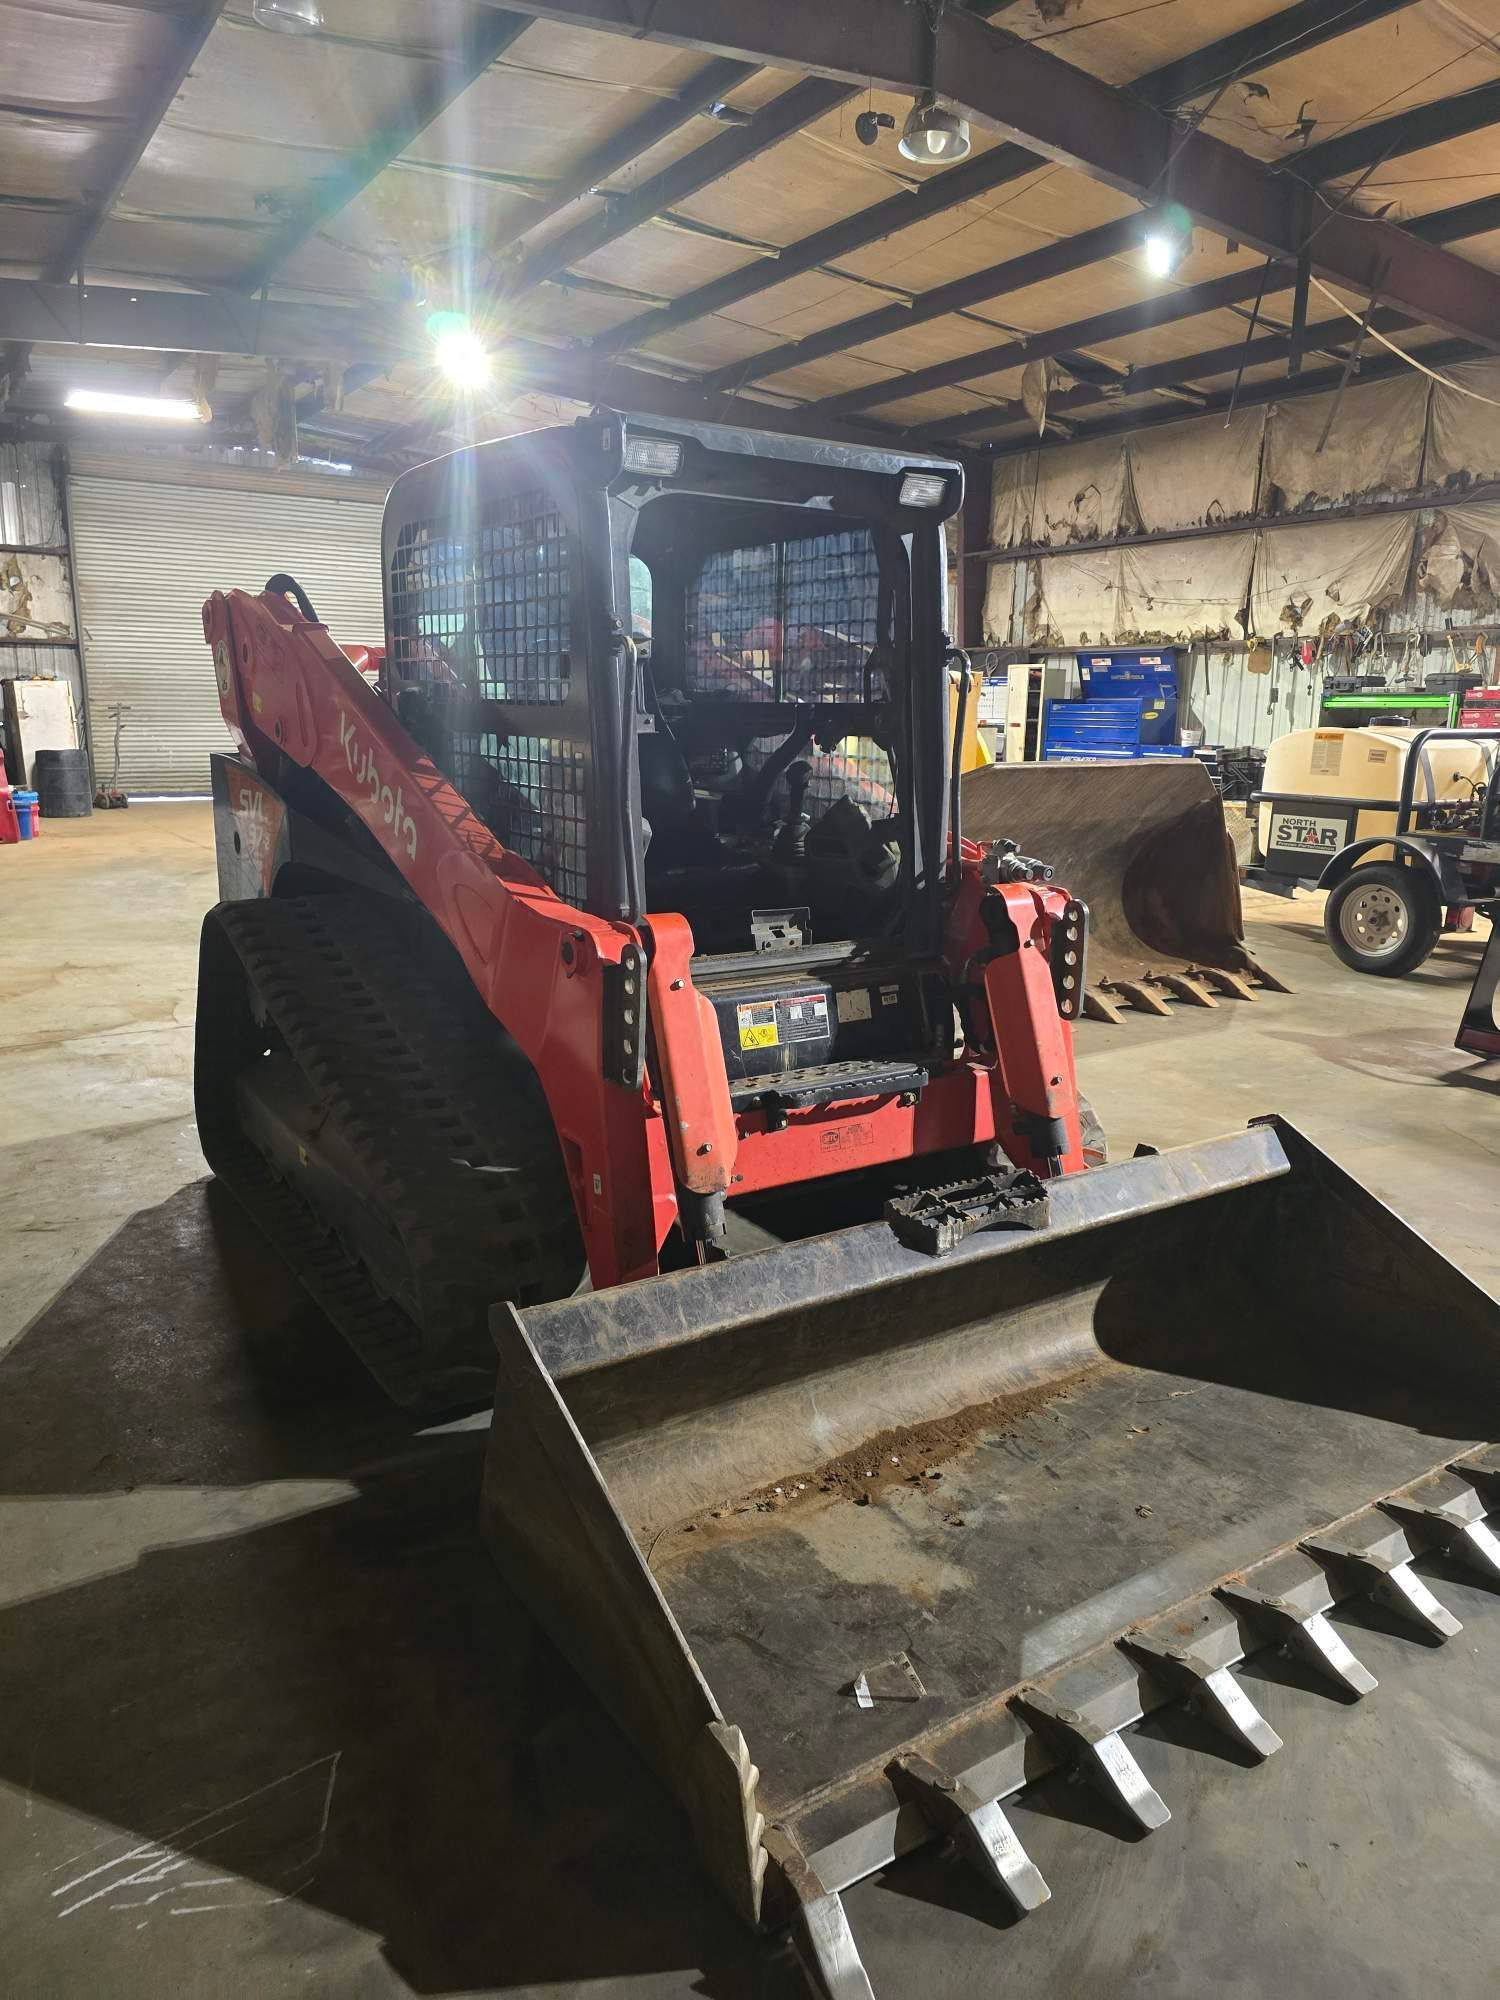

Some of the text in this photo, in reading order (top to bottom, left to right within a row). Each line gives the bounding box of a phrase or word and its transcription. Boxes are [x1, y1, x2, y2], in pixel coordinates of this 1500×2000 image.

[340, 710, 417, 863] Kubota
[1282, 817, 1316, 827] NORTH
[1277, 825, 1338, 845] STAR
